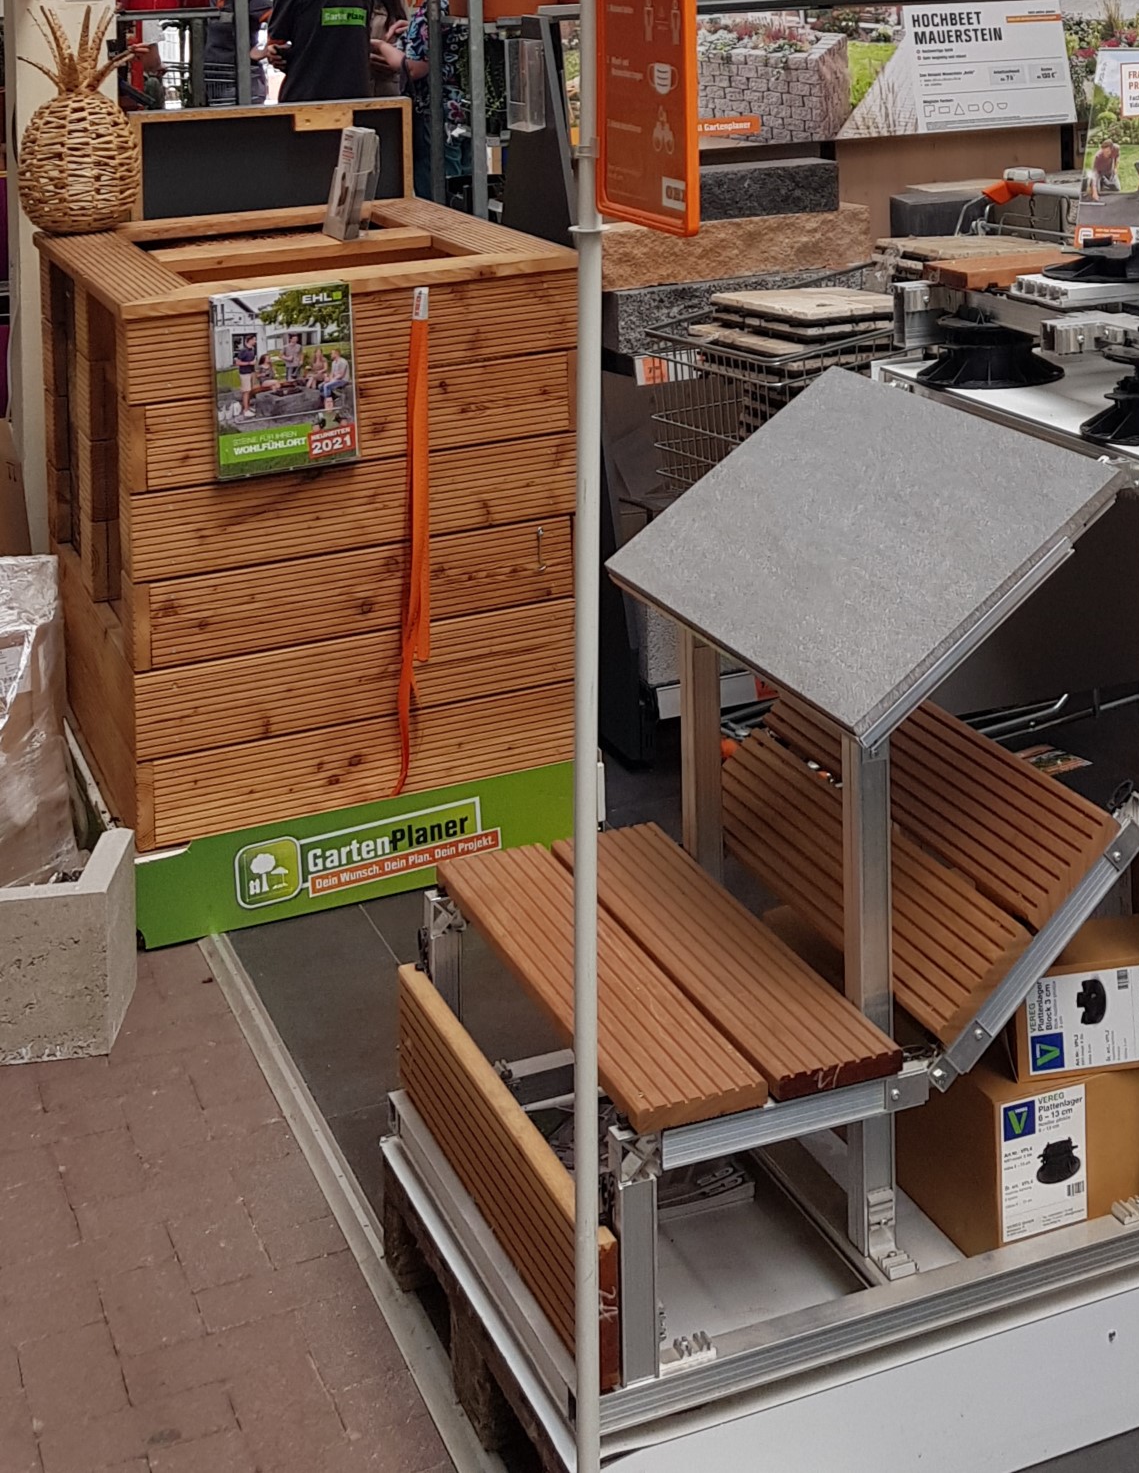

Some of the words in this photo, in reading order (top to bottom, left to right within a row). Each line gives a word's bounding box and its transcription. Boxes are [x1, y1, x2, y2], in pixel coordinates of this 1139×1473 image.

[912, 11, 982, 28] HOCHBEET
[914, 27, 1003, 45] MAUERSTEIN
[302, 294, 332, 304] EHL
[311, 426, 351, 441] NEUHEITEN
[233, 435, 307, 456] WOHLFÜHLORT
[311, 435, 352, 455] 2021
[307, 815, 469, 873] GartenPlaner
[315, 875, 338, 890] Dein
[340, 864, 382, 882] Wunsch.
[384, 857, 407, 871] Dein
[408, 853, 433, 867] Plan.
[434, 845, 457, 859] Dein
[458, 835, 496, 854] Projekt.
[1044, 983, 1051, 997] cm
[1044, 1007, 1053, 1030] Block
[1038, 1092, 1065, 1105] VEREG
[1038, 1097, 1083, 1114] Plattenlager
[1051, 1111, 1059, 1119] 13
[1060, 1107, 1073, 1117] cm
